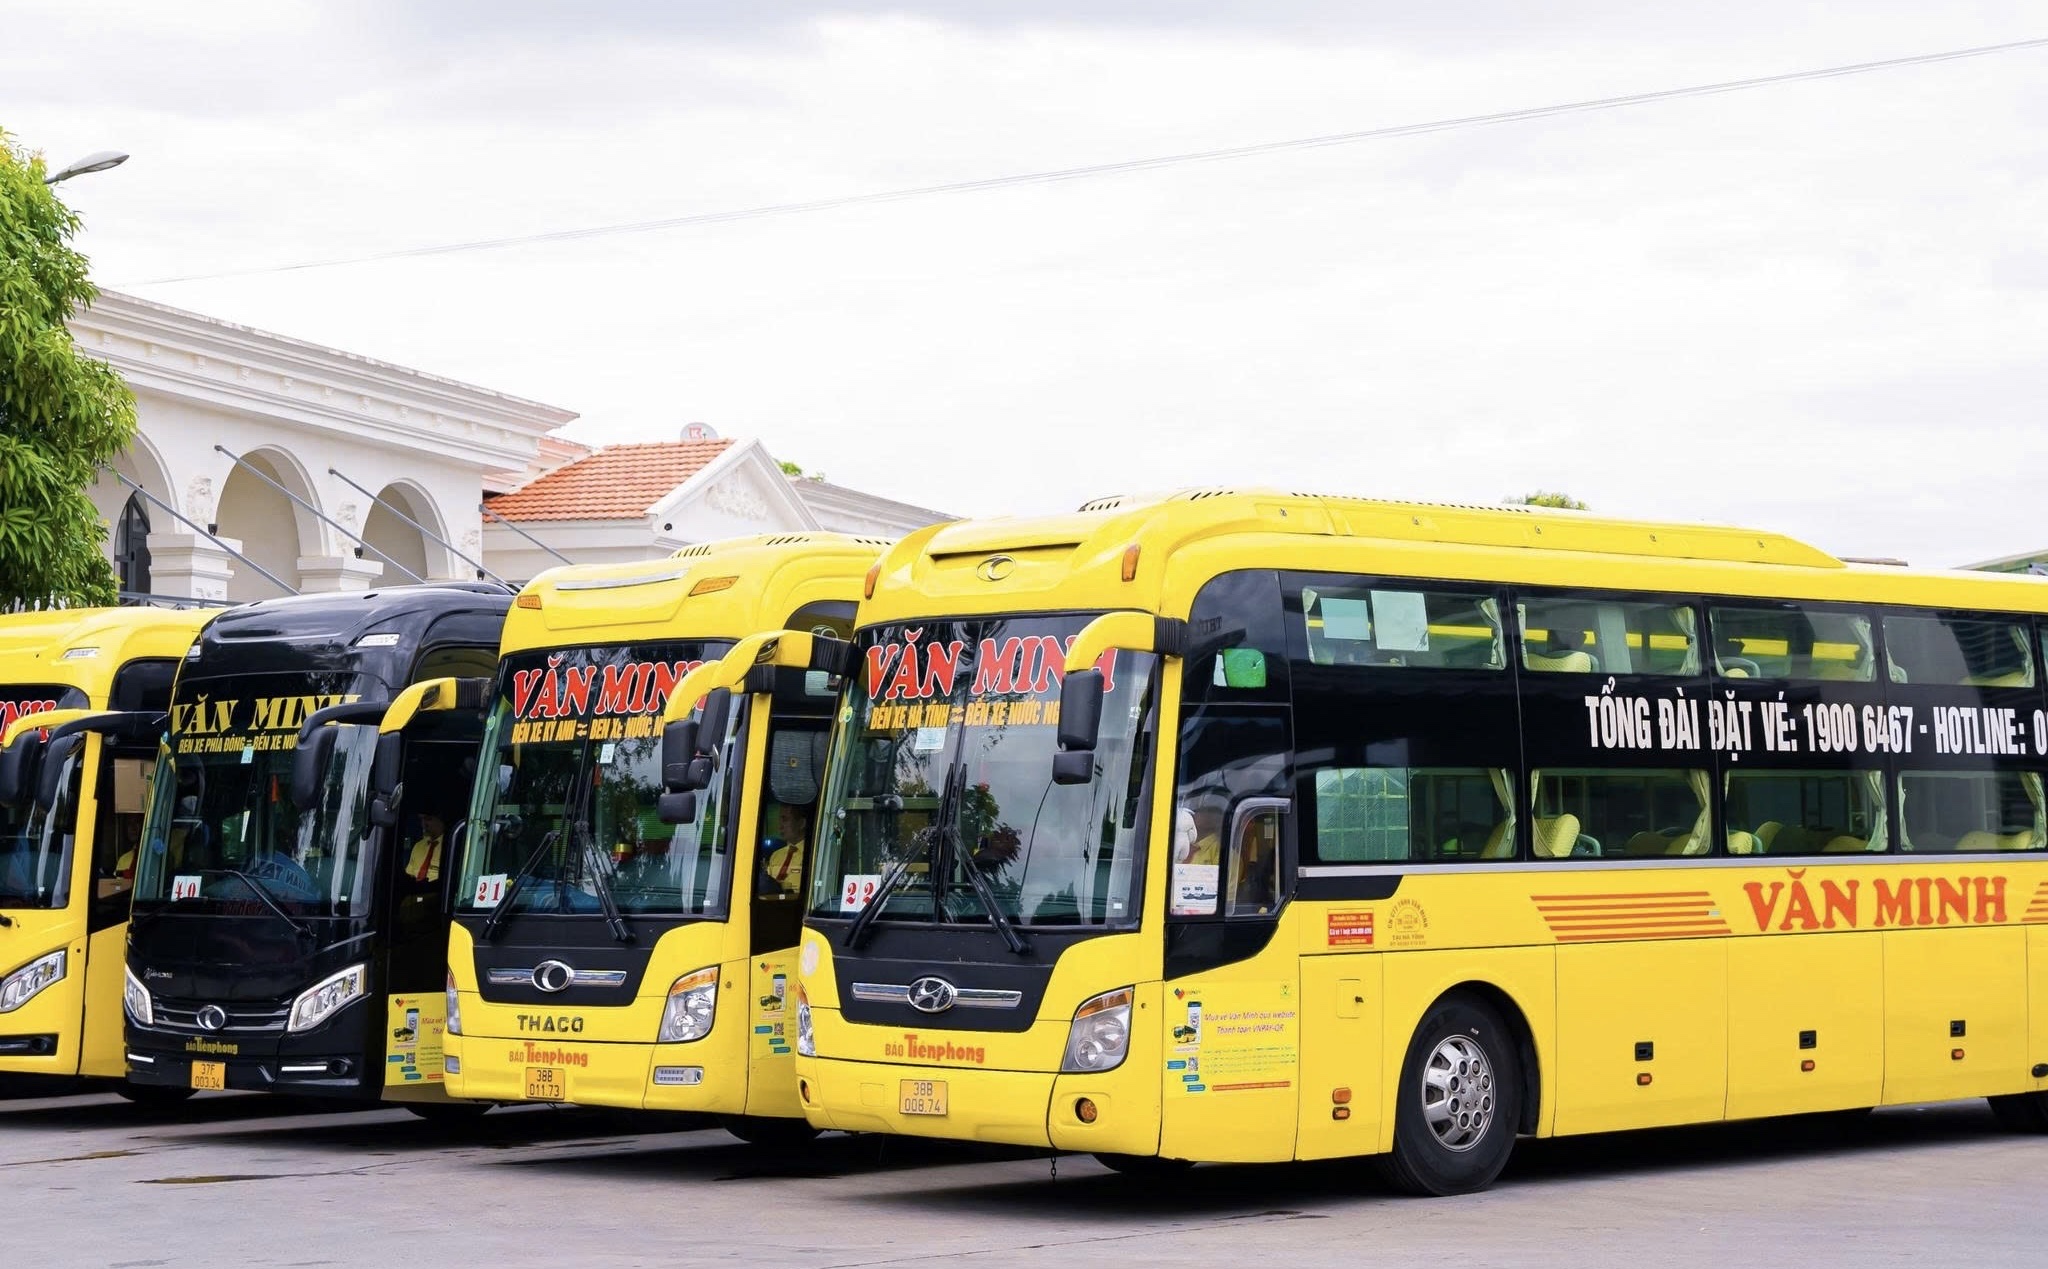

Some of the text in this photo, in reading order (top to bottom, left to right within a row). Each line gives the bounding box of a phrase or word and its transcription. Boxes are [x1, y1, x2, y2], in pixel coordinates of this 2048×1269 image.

[866, 627, 963, 699] VĂN
[513, 654, 708, 718] VĂN MIN
[172, 693, 239, 736] VĂN
[892, 705, 907, 729] XE
[990, 701, 1008, 725] XE
[1584, 676, 1652, 749] TỔNG
[1658, 687, 1700, 750] ĐÀI
[1708, 690, 1752, 761] ĐẶT
[1760, 691, 1798, 752] VÉ:
[1803, 703, 1858, 752] 1900
[1862, 704, 1913, 753] 6467
[1933, 706, 2026, 755] HOTLINE:
[529, 722, 544, 742] XE
[555, 720, 577, 741] ANH
[194, 738, 205, 753] XE
[270, 734, 283, 750] XE
[1743, 867, 2007, 932] VĂN MINH
[517, 1014, 584, 1033] THACO
[201, 1063, 215, 1075] 37F
[536, 1069, 553, 1082] 38B
[194, 1075, 220, 1088] 003.34
[529, 1083, 560, 1097] 011.73
[913, 1082, 933, 1097] 38B
[904, 1098, 941, 1113] 008.74
